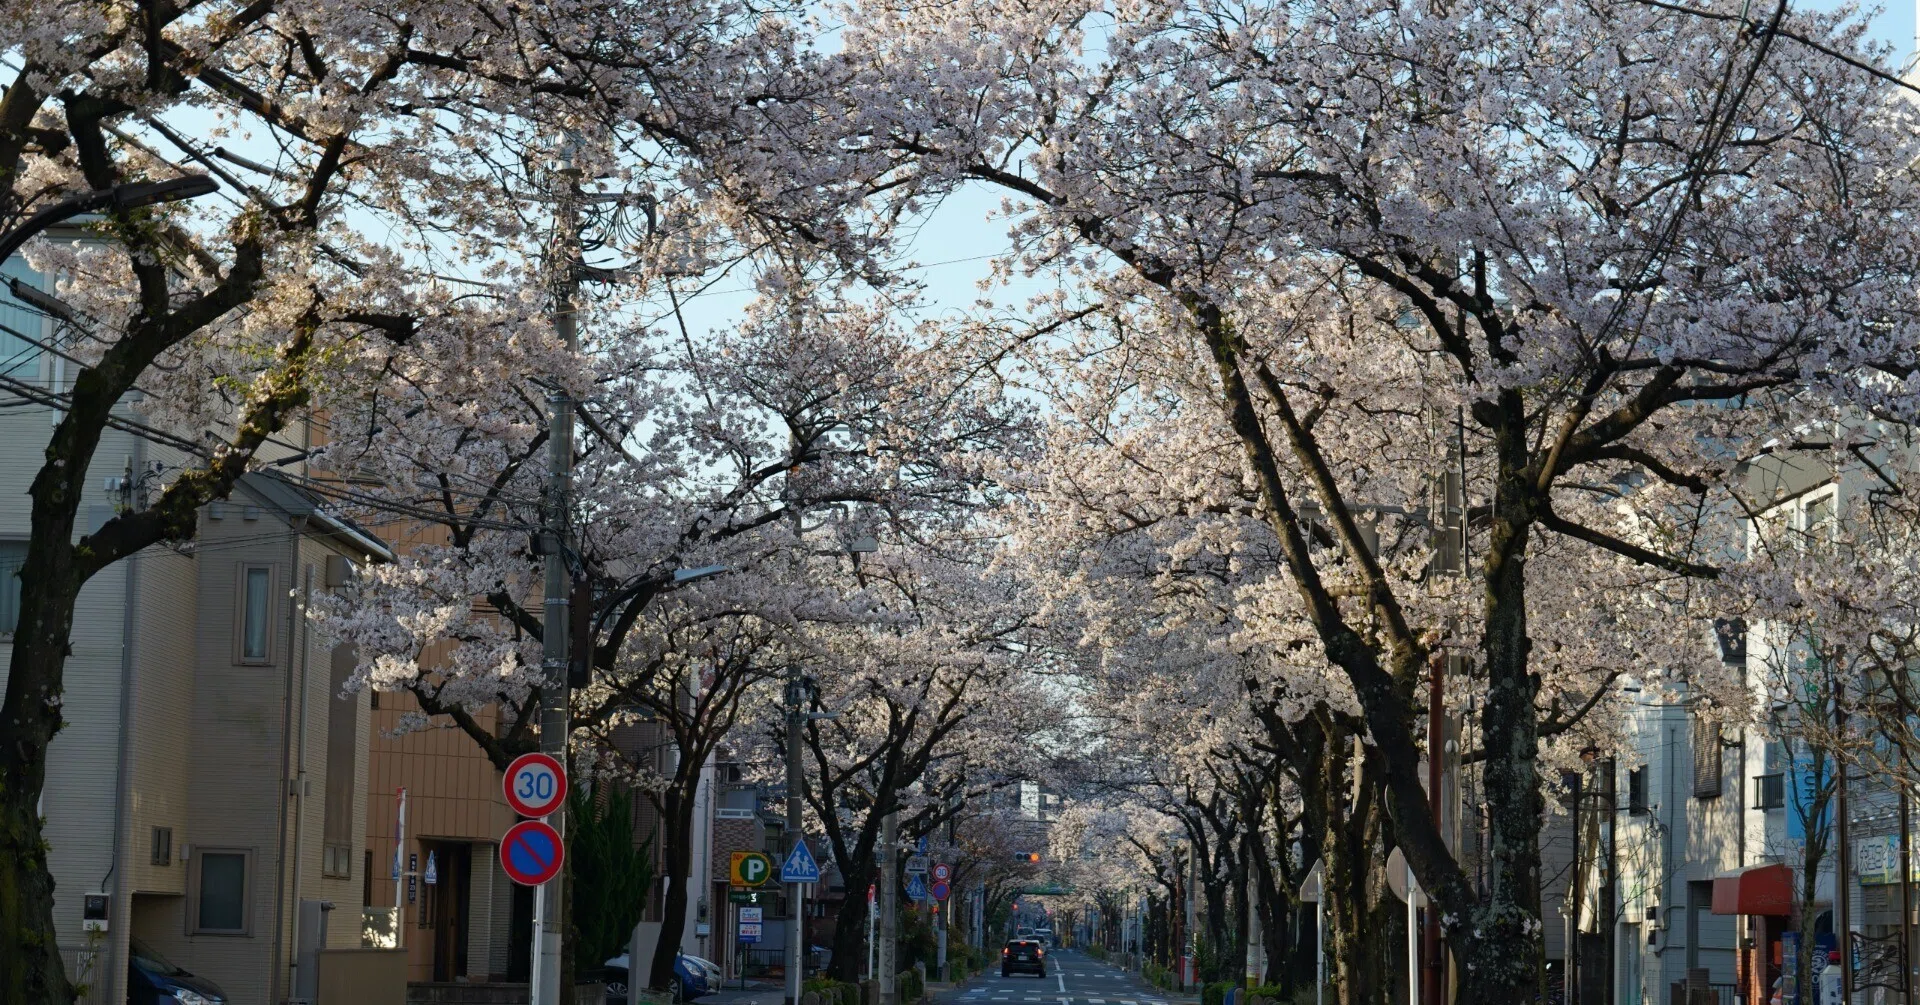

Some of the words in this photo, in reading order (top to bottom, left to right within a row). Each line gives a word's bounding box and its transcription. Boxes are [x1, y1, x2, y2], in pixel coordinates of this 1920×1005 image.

[518, 771, 553, 799] 30
[748, 859, 764, 881] P
[937, 868, 947, 877] 30
